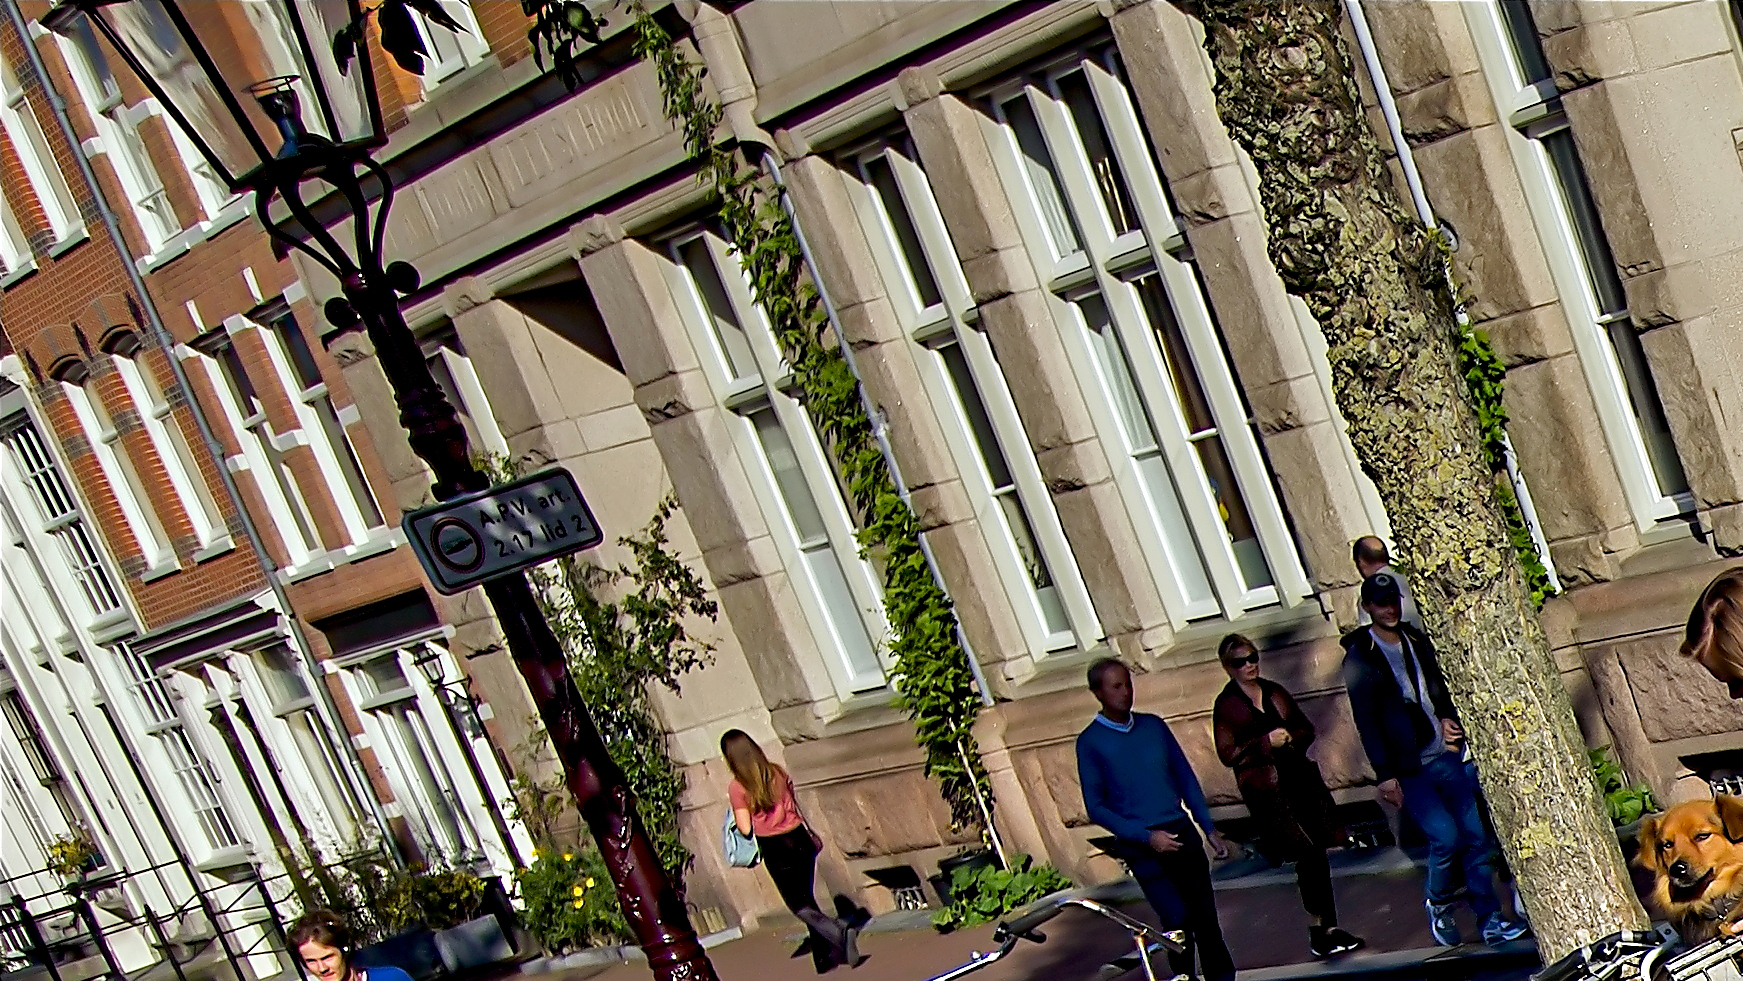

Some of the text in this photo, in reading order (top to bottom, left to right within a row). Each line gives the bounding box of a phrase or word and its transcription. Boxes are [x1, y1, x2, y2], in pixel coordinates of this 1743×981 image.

[479, 489, 572, 528] A.P.V. art.
[494, 514, 588, 558] 2.17 lid 2
